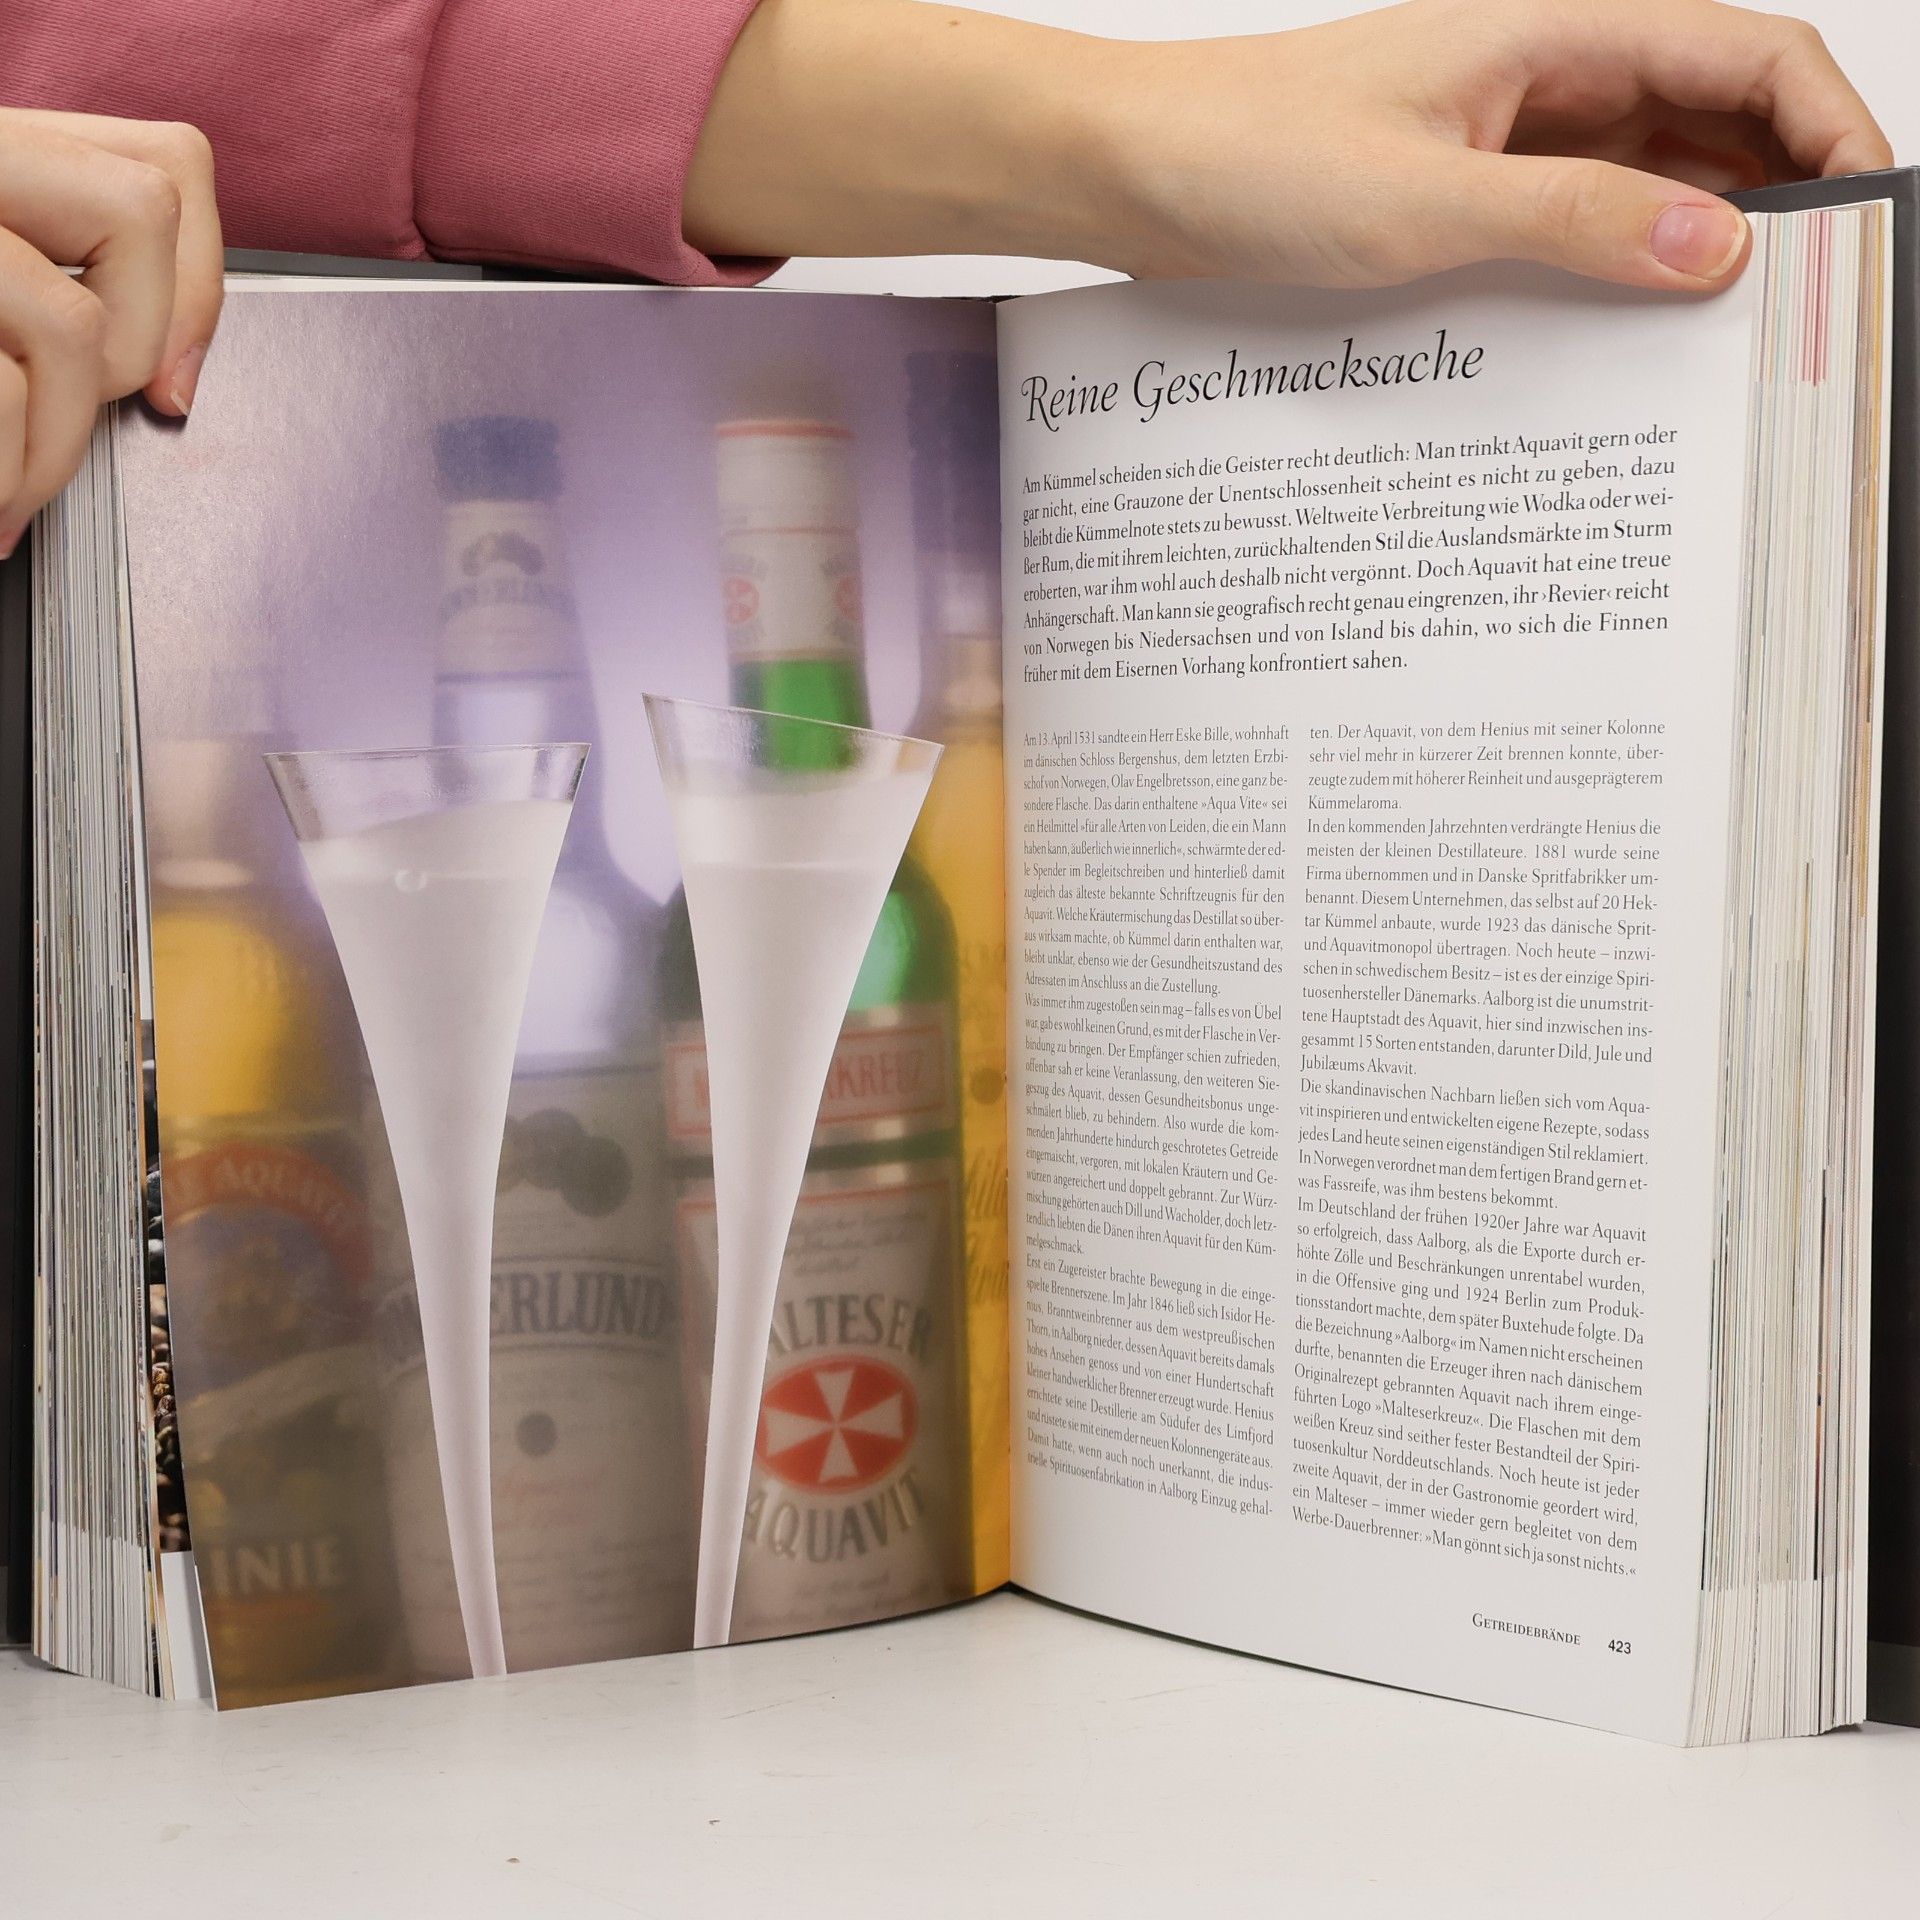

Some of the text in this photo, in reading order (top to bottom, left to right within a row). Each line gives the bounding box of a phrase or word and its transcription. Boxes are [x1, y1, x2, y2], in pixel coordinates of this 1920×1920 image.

[1022, 329, 1483, 432] Reine Geschmacksache
[1023, 424, 1677, 494] Am Kümmel scheiden sich die Geister recht deutlich: Man trinkt Aquavit gern oder
[1023, 456, 1674, 526] gar nicht, eine Grauzone der Unentschlossenheit scheint es nicht zu geben, dazu
[1024, 520, 1671, 574] ßer Rum, die mit ihrem leichten, zurückhaltenden Stil die Auslandsmärkte im Sturm
[1025, 604, 1118, 631] Anhängerschaft.
[1122, 604, 1153, 621] Man
[1157, 602, 1191, 619] kann
[1195, 601, 1214, 617] sie
[1217, 594, 1305, 622] geografisch
[1309, 592, 1350, 612] recht
[1354, 597, 1404, 616] genau
[1408, 591, 1508, 612] eingrenzen,
[1514, 585, 1539, 603] ihr
[1616, 579, 1669, 600] reicht
[1024, 650, 1407, 682] früher mit dem Eisernen Vorhang konfrontiert sahen.
[1310, 719, 1665, 742] ten. Der Aquavit, von dem Henius mit seiner Kolonne
[1035, 753, 1077, 767] dänischen
[1080, 752, 1115, 766] Schloss
[1184, 749, 1208, 764] dem
[1212, 749, 1249, 764] letzten
[1094, 797, 1112, 810] Das
[1114, 796, 1139, 810] darin
[1142, 795, 1198, 810] enthaltene
[1271, 797, 1287, 809] sei
[1309, 794, 1401, 809] Kümmelaroma.
[1307, 842, 1660, 860] meisten der kleinen Destillateure. 1881 wurde seine
[1058, 884, 1073, 898] das
[1076, 885, 1106, 899] älteste
[1110, 885, 1155, 900] bekannte
[1160, 886, 1237, 905] Schriftzeugnis
[1242, 887, 1258, 902] für
[1263, 888, 1284, 903] den
[1301, 1034, 1652, 1063] gesammt 15 Sorten entstanden, darunter Dild, Jule und
[1298, 1125, 1648, 1165] jedes Land heute seinen eigenständigen Stil reklamiert.
[1298, 1196, 1646, 1243] Im Deutschland der frühen 1920er Jahre war Aquavit
[1044, 1262, 1055, 1271] ein
[1058, 1259, 1106, 1280] Zugereister
[1110, 1266, 1145, 1286] brachte
[1150, 1273, 1202, 1297] Bewegung
[1206, 1282, 1216, 1295] in
[1221, 1282, 1237, 1298] die
[1297, 1269, 1644, 1318] in die Offensive ging und 1924 Berlin zum Produk-
[745, 1464, 924, 1565] AQUAVIT
[1464, 1538, 1501, 1555] gönnt
[1504, 1543, 1530, 1559] sich
[1532, 1547, 1544, 1564] ja
[1547, 1553, 1580, 1568] sonst
[1608, 1639, 1631, 1654] 423
